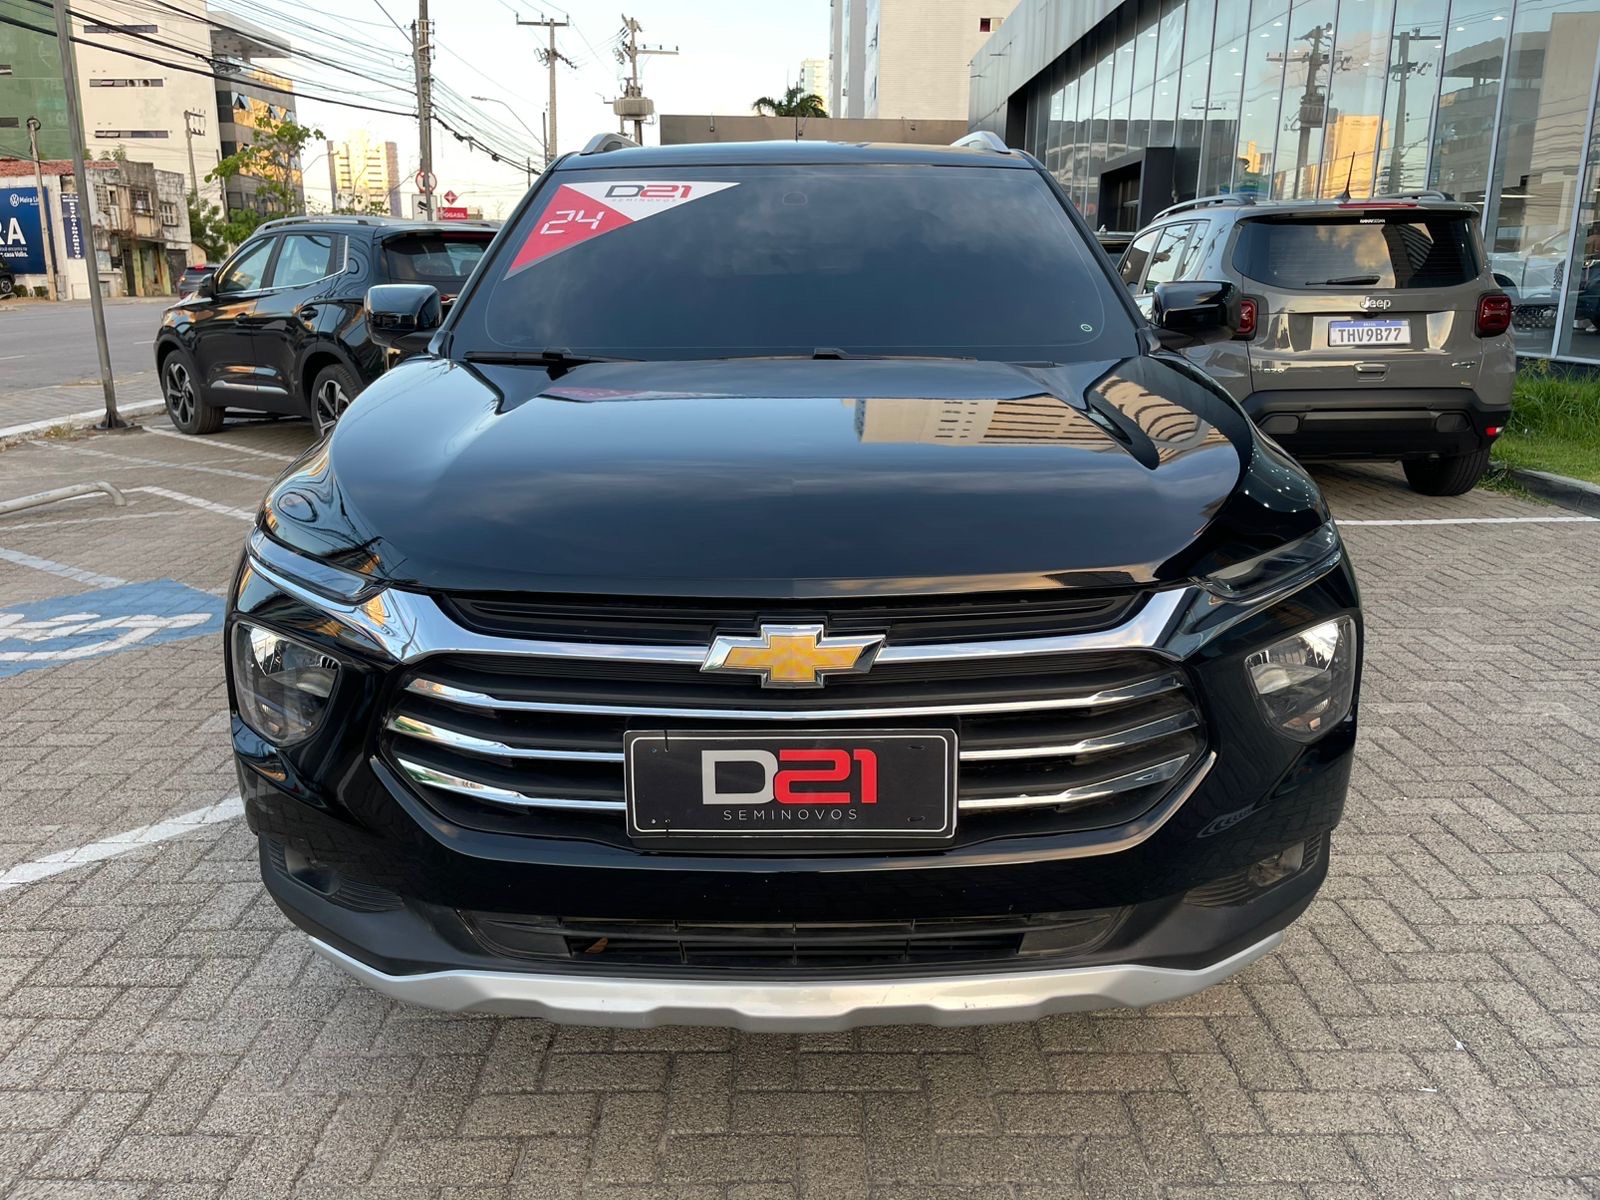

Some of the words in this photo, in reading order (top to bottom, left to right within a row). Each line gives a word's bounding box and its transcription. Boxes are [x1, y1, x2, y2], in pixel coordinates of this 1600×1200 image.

[605, 185, 692, 198] D21
[540, 210, 605, 235] 24
[1360, 297, 1391, 309] Jeep
[1338, 328, 1402, 342] THV9B77
[701, 749, 877, 805] D21
[723, 808, 858, 821] SEMINOVOS
